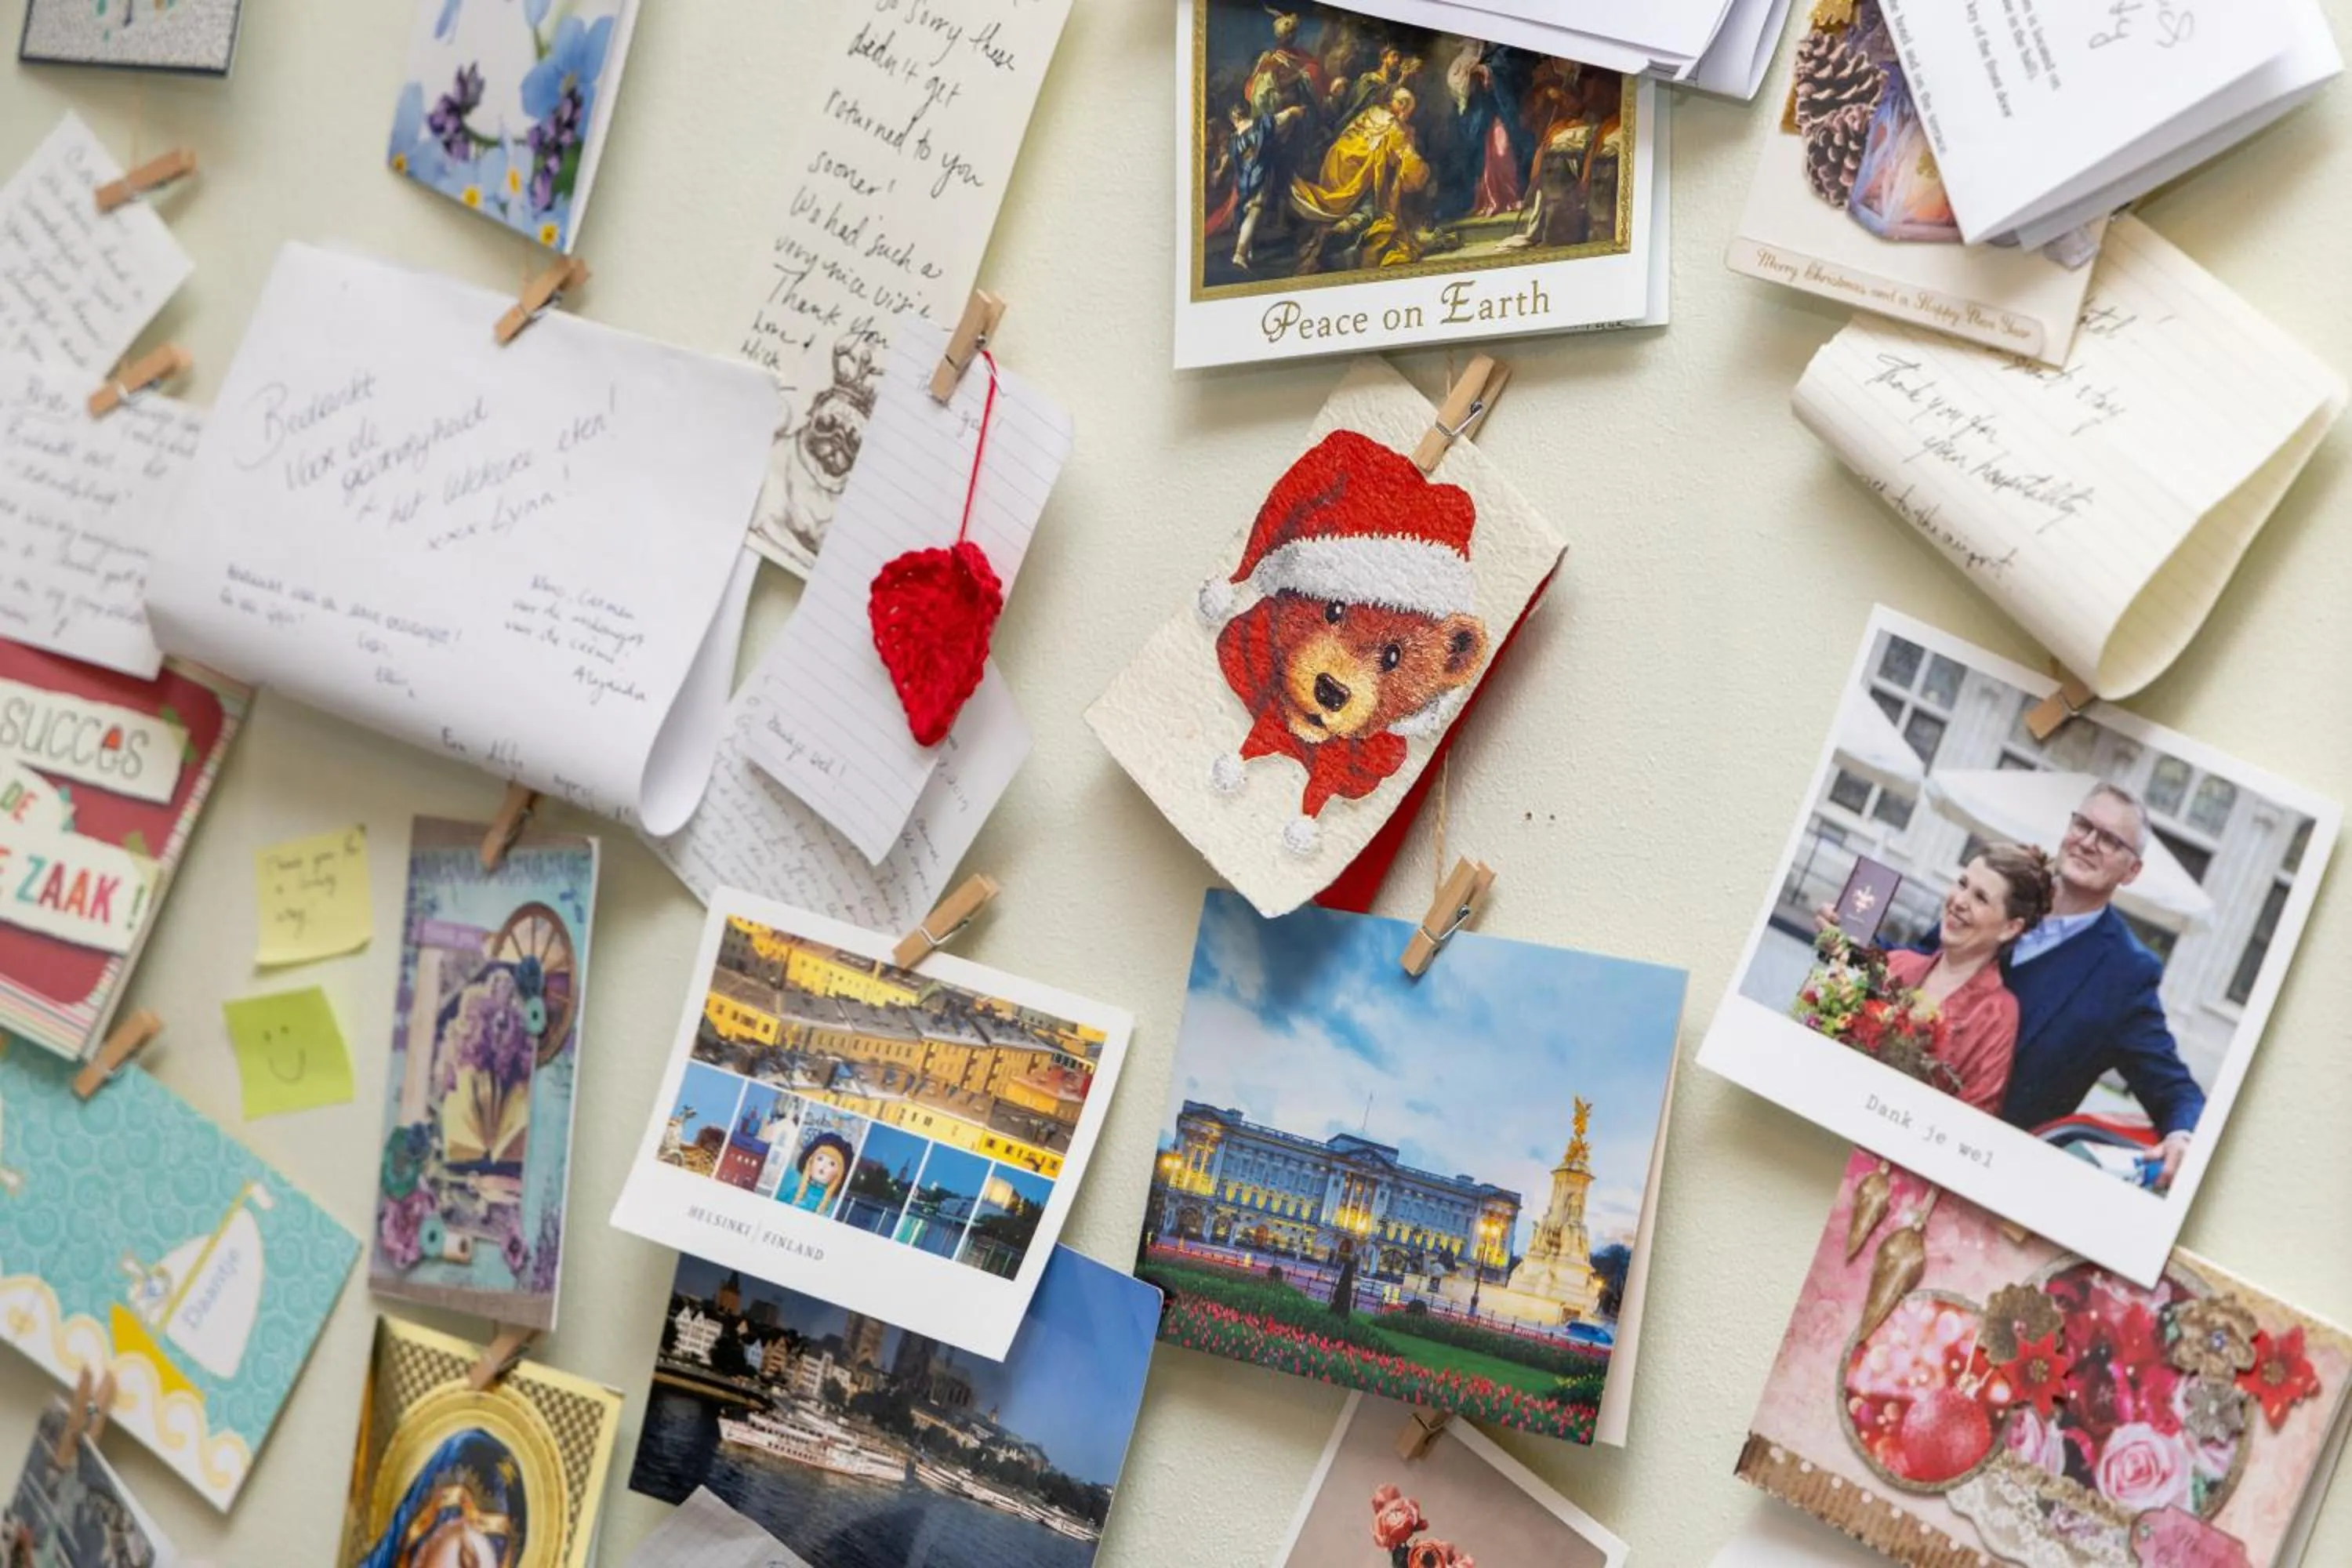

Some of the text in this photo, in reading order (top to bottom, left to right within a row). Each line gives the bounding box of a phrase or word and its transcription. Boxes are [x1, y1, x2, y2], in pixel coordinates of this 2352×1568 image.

[914, 127, 932, 161] to
[931, 152, 985, 199] you
[1802, 260, 1867, 296] Christmas
[1261, 279, 1551, 343] Peace on Earth
[1864, 1092, 1994, 1169] Dank je wel
[687, 1203, 826, 1261] HELSINKI FINLAND
